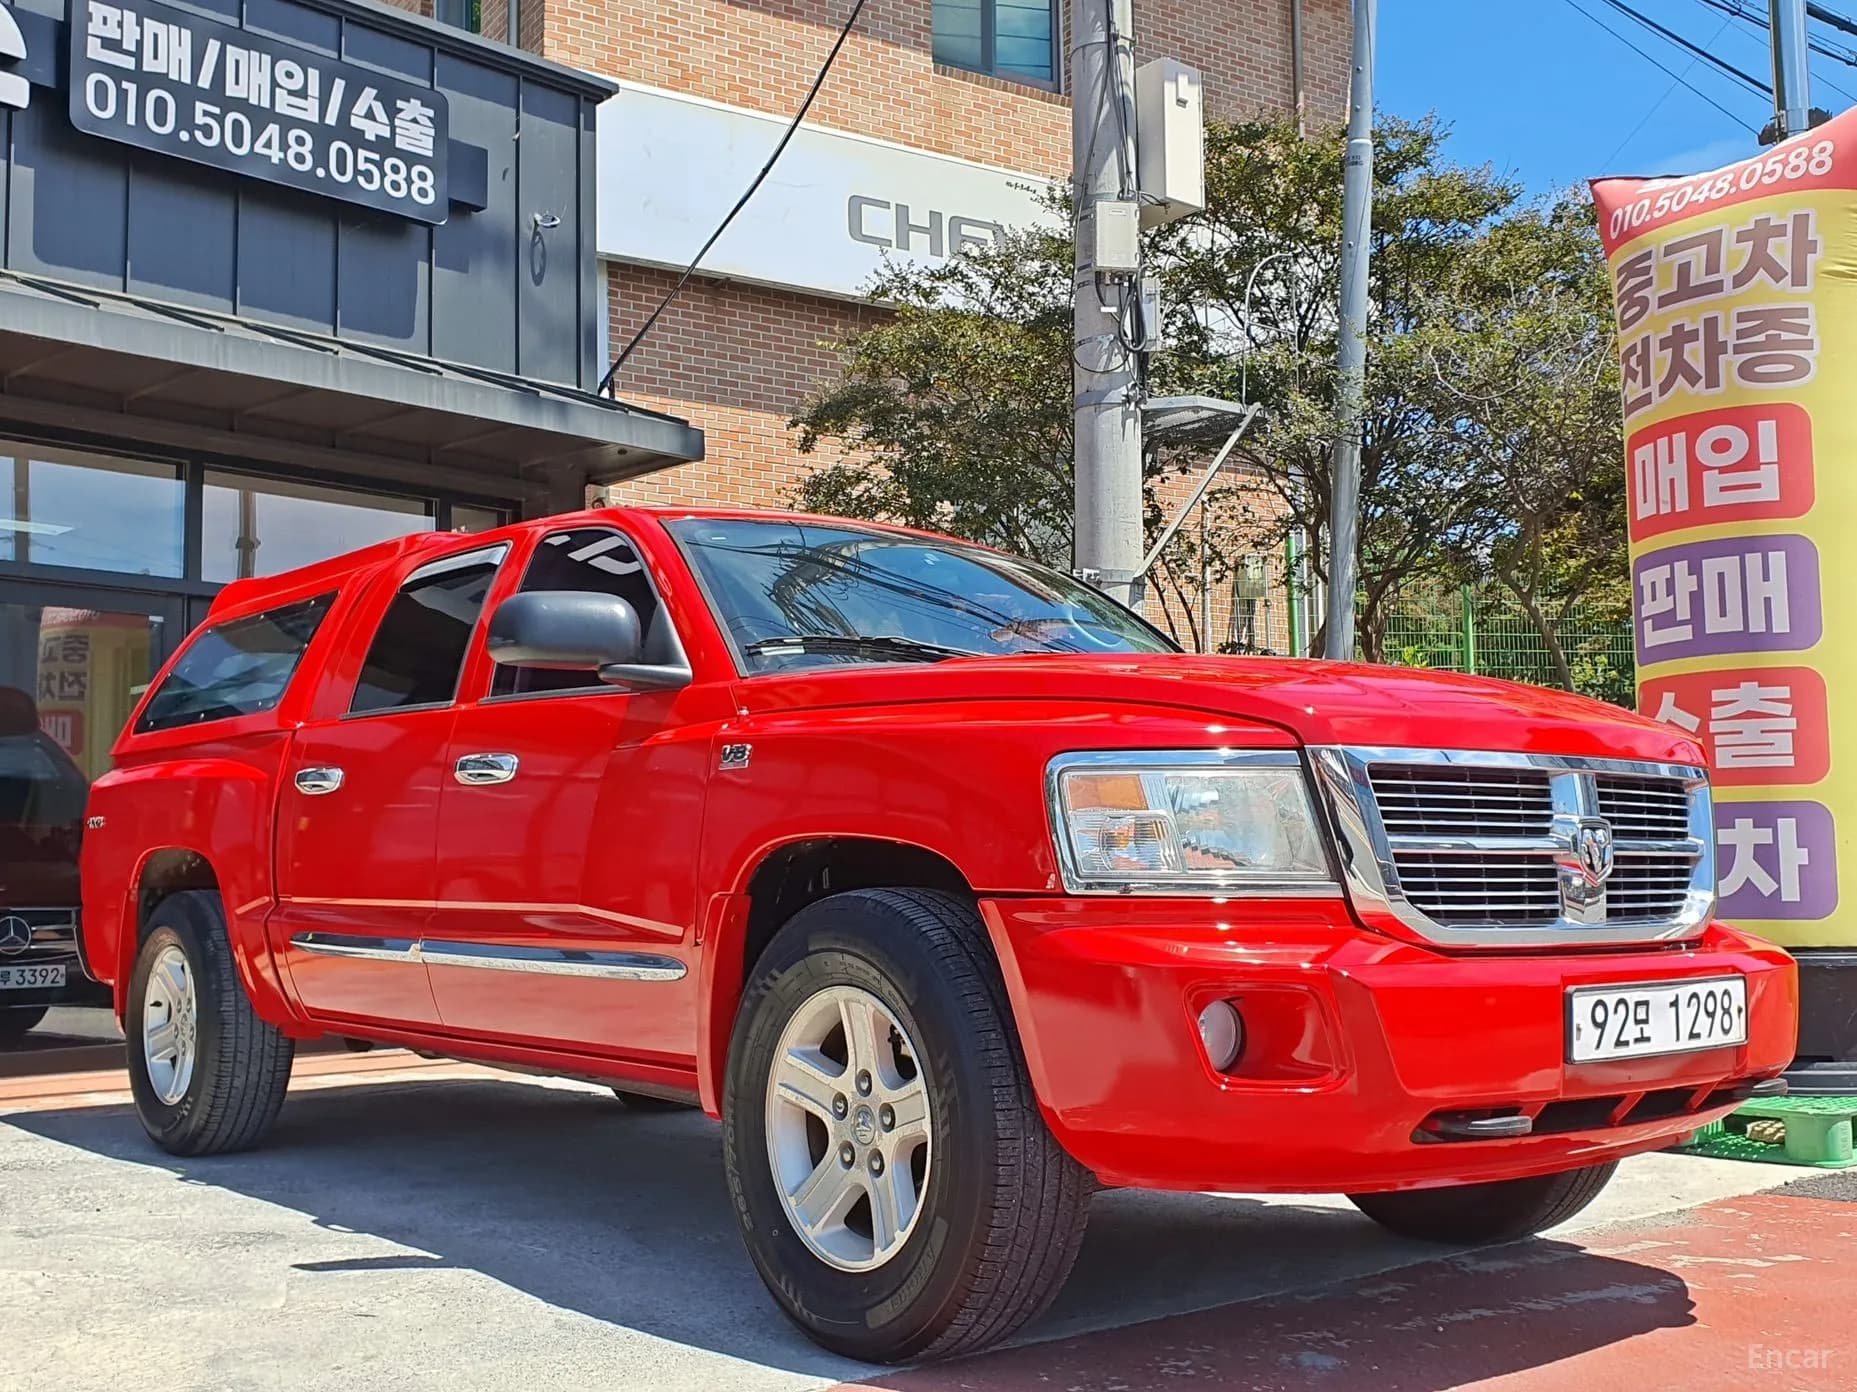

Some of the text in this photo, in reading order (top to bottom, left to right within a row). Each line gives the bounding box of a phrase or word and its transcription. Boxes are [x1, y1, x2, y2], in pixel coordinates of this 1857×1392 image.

[86, 1, 435, 158] 판매/매입/수출
[85, 73, 436, 205] 010.5048.0588
[1609, 140, 1834, 240] 010.5048.0588
[1615, 211, 1819, 332] 중고차
[1622, 307, 1815, 417] 전차종
[1634, 420, 1780, 521] 매입
[1640, 551, 1790, 648] 판매
[15, 967, 60, 985] 3392
[1591, 989, 1733, 1050] 92모 1298
